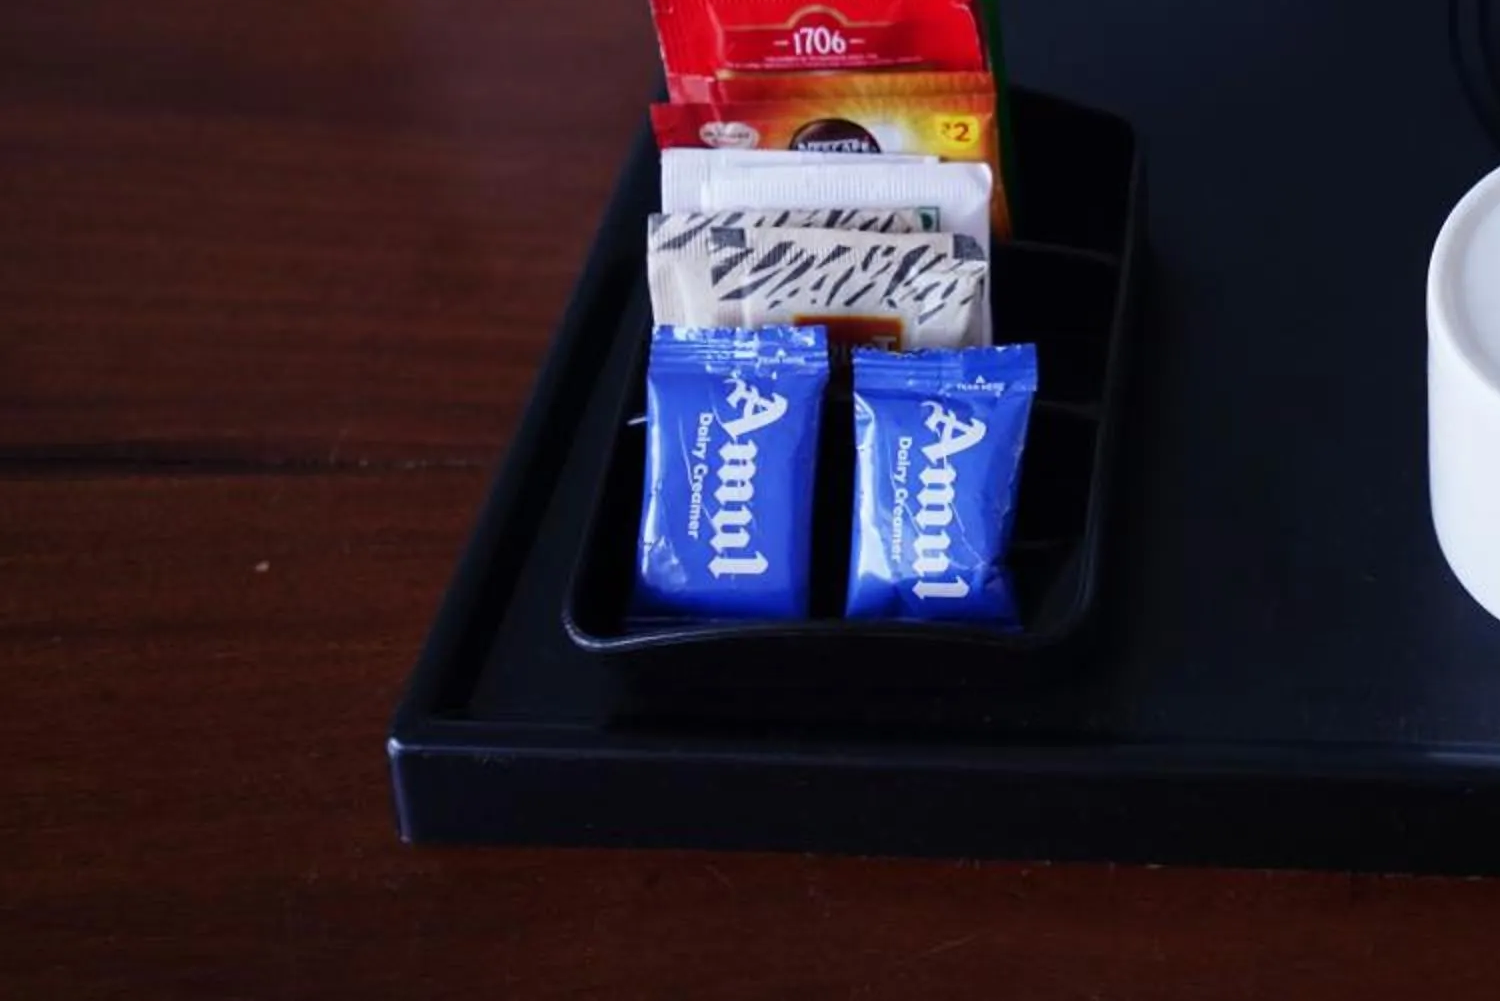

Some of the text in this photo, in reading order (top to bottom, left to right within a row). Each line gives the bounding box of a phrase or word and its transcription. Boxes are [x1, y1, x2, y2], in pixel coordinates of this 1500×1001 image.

[793, 26, 847, 56] 1706
[687, 412, 713, 540] Dairy Creamer
[707, 379, 788, 580] Amul
[891, 436, 913, 564] Dairy Creamer
[912, 401, 987, 600] Amul
